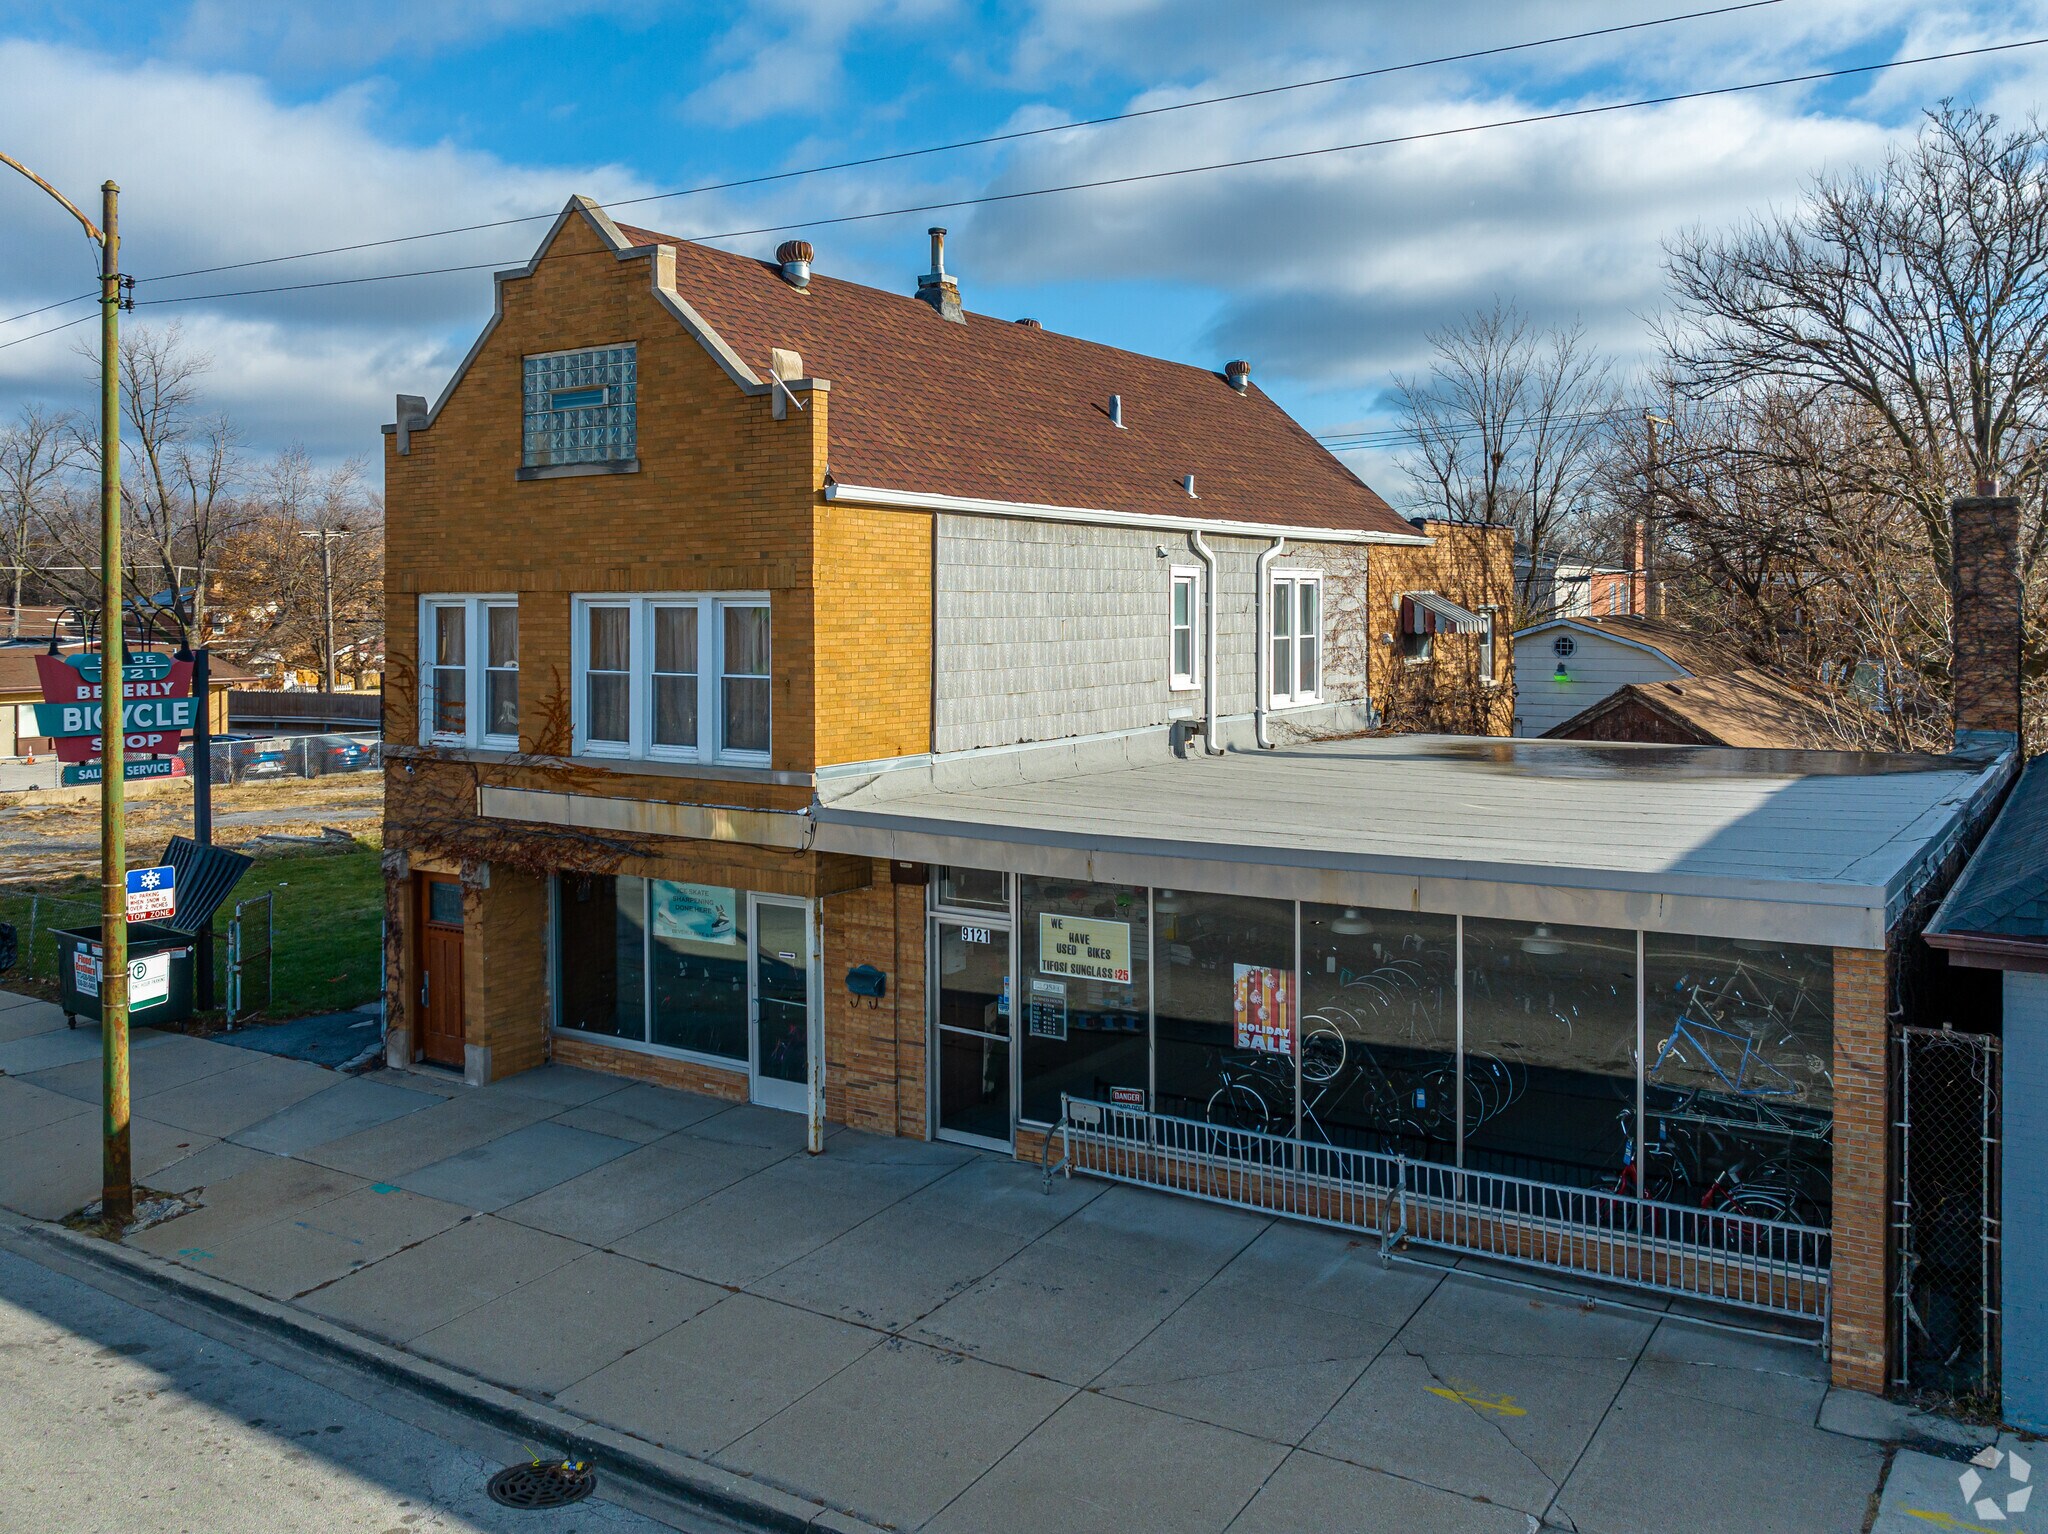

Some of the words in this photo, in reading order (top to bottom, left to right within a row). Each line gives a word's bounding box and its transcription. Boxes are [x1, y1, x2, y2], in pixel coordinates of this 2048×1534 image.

[77, 682, 174, 700] BEERLY
[91, 734, 163, 752] SOP
[126, 763, 170, 776] SERVICE
[673, 896, 714, 905] SHARPENING
[150, 909, 170, 918] ZONE
[1051, 918, 1063, 929] WE
[963, 927, 989, 943] 9121
[1069, 932, 1090, 945] HAVE
[1056, 943, 1077, 955] USED
[1087, 947, 1111, 960] BIKES
[1042, 960, 1067, 973] TIFOSI
[1070, 963, 1113, 979] SUNGLASS
[1238, 1022, 1290, 1037] HOLIDAY
[1238, 1033, 1291, 1054] SALE
[1114, 1092, 1140, 1102] DANGER
